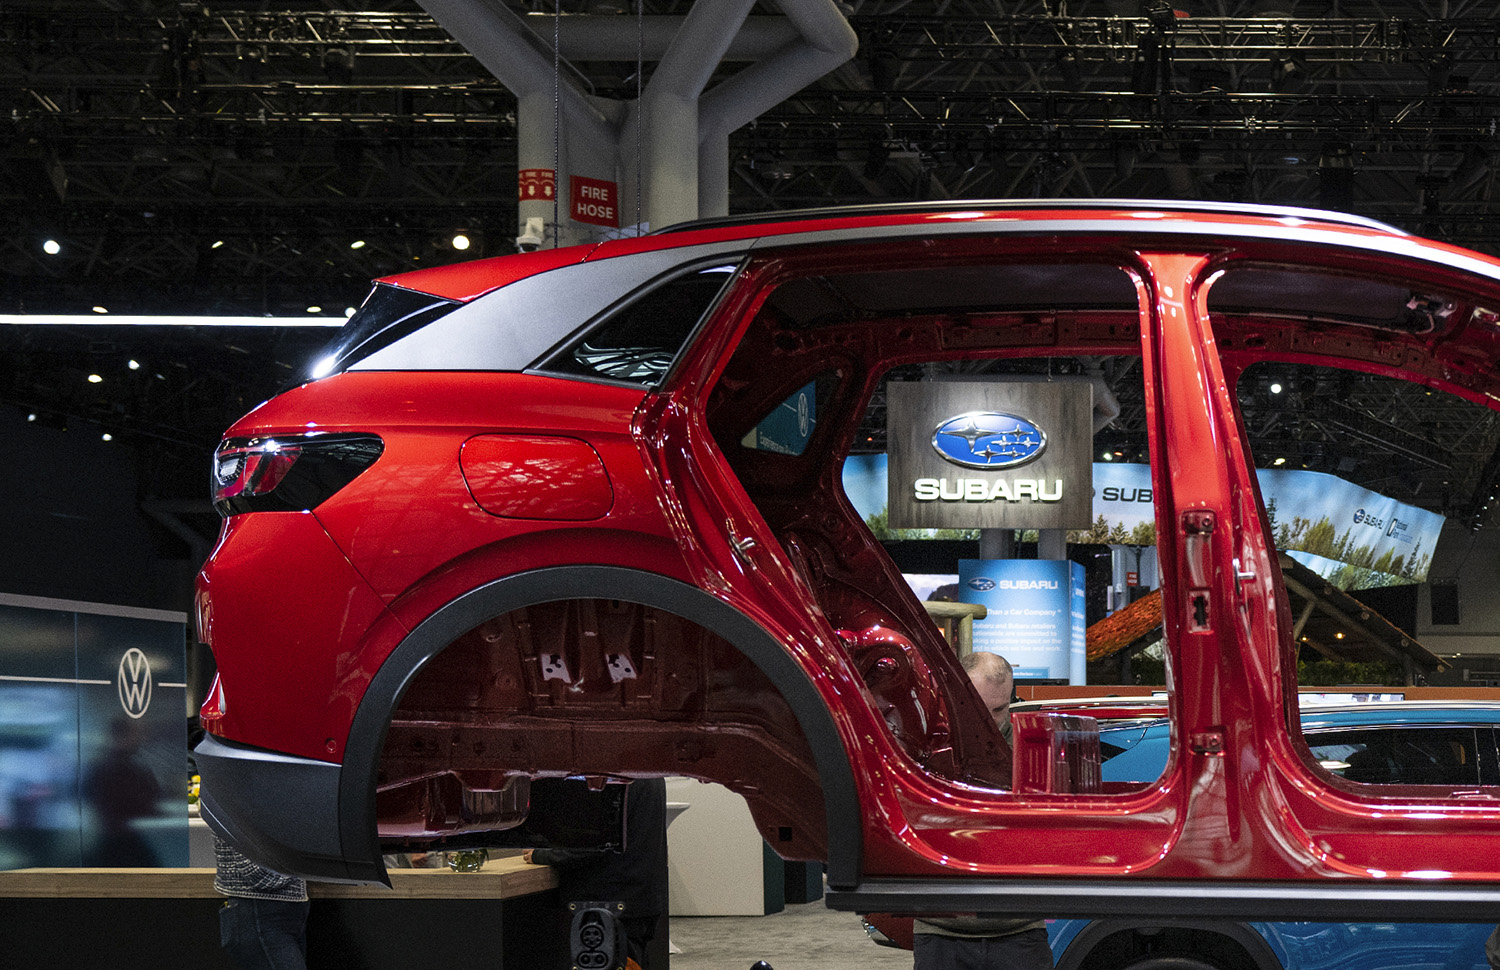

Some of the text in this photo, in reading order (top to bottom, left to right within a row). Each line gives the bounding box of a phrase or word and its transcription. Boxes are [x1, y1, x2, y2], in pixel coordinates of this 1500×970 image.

[581, 186, 608, 200] FIRE
[577, 203, 613, 219] HOSE
[914, 478, 1063, 500] SUBARU
[1102, 487, 1154, 502] SUB
[1000, 580, 1058, 589] SUBARU
[1024, 609, 1056, 617] Company
